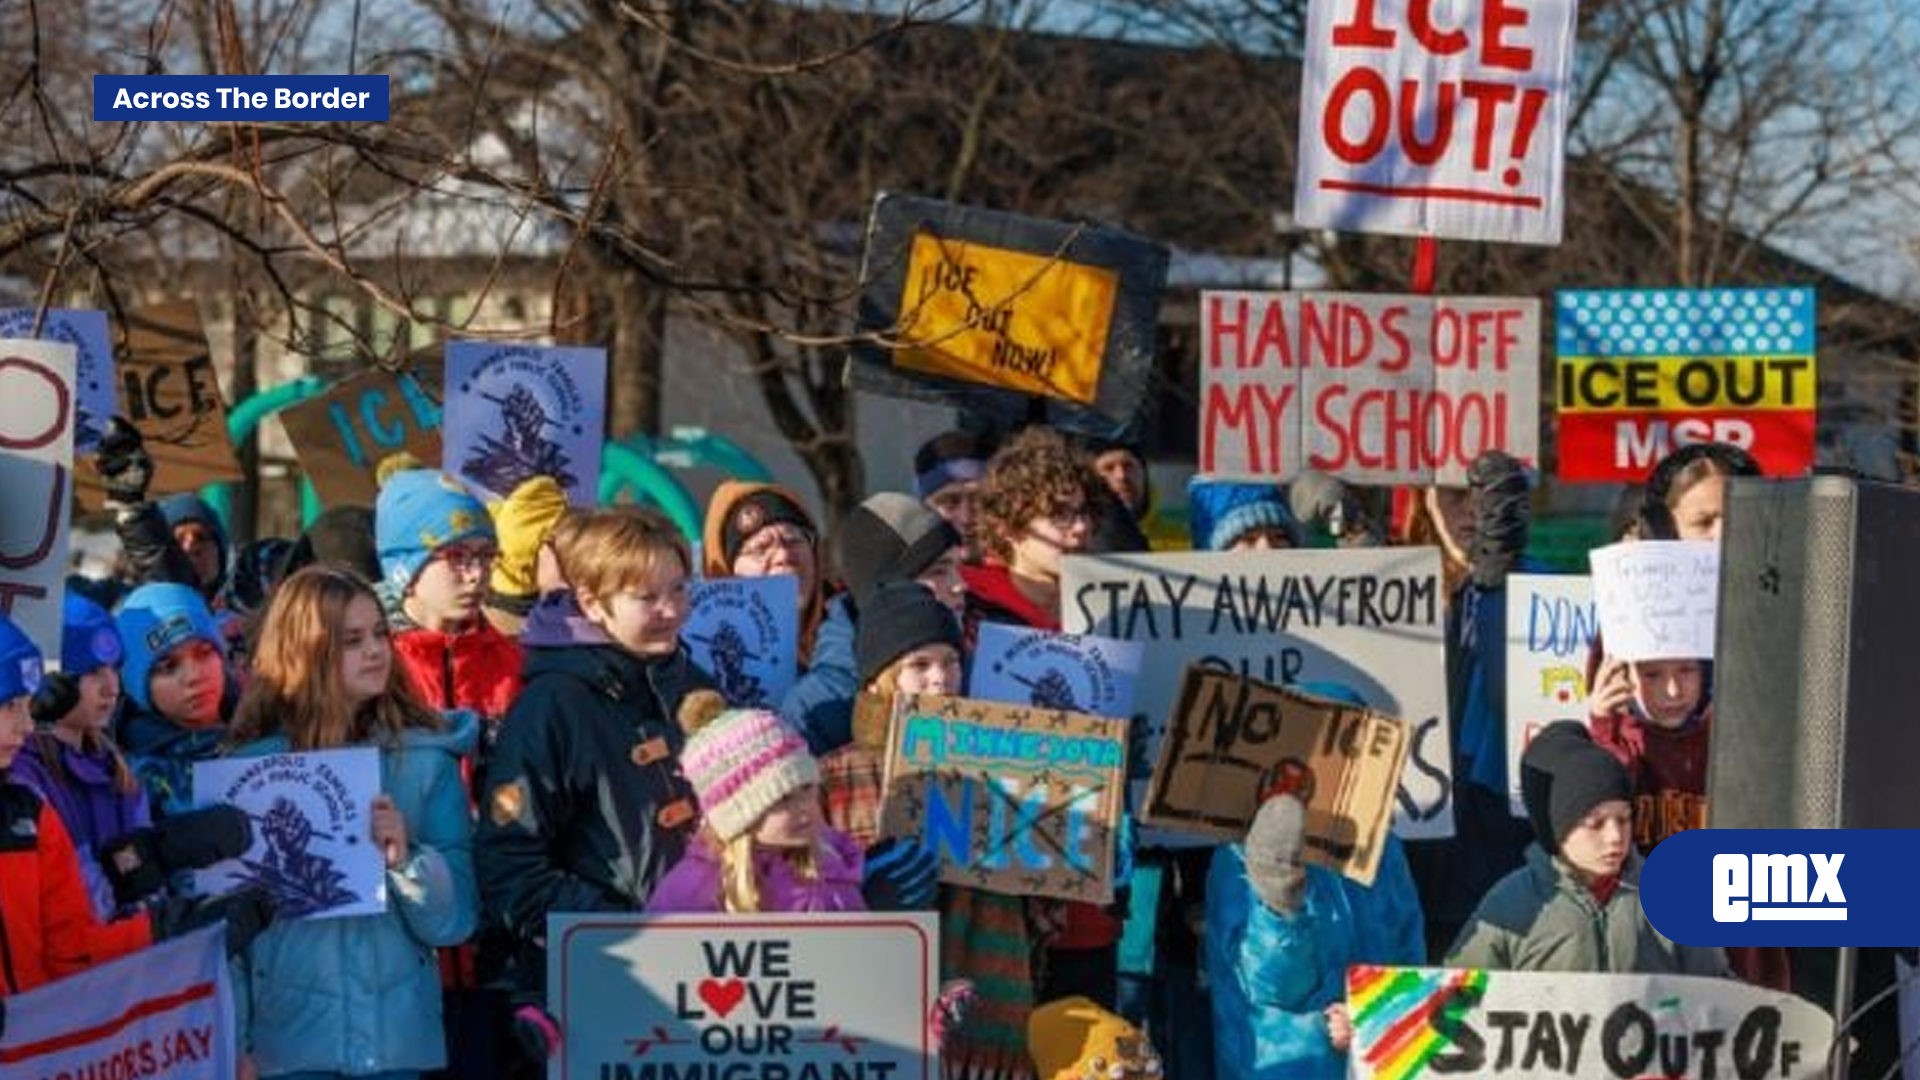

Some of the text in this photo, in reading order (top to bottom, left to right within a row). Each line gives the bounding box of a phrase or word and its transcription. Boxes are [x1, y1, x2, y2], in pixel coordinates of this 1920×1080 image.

[1323, 66, 1548, 187] OUT!
[991, 341, 1057, 377] NOW!
[1210, 297, 1523, 373] HANDS OFF
[123, 355, 216, 421] ICE
[1561, 359, 1808, 408] ICE OUT
[1203, 382, 1533, 475] MY SCHOOL
[1076, 573, 1436, 640] STAY AWAY FROM
[904, 715, 1125, 767] MINNESOTA
[922, 774, 1100, 871] NICE
[702, 940, 790, 977] WE
[162, 1023, 213, 1069] SAY
[700, 1025, 794, 1055] OUR
[1428, 986, 1800, 1080] STAY OUT OF
